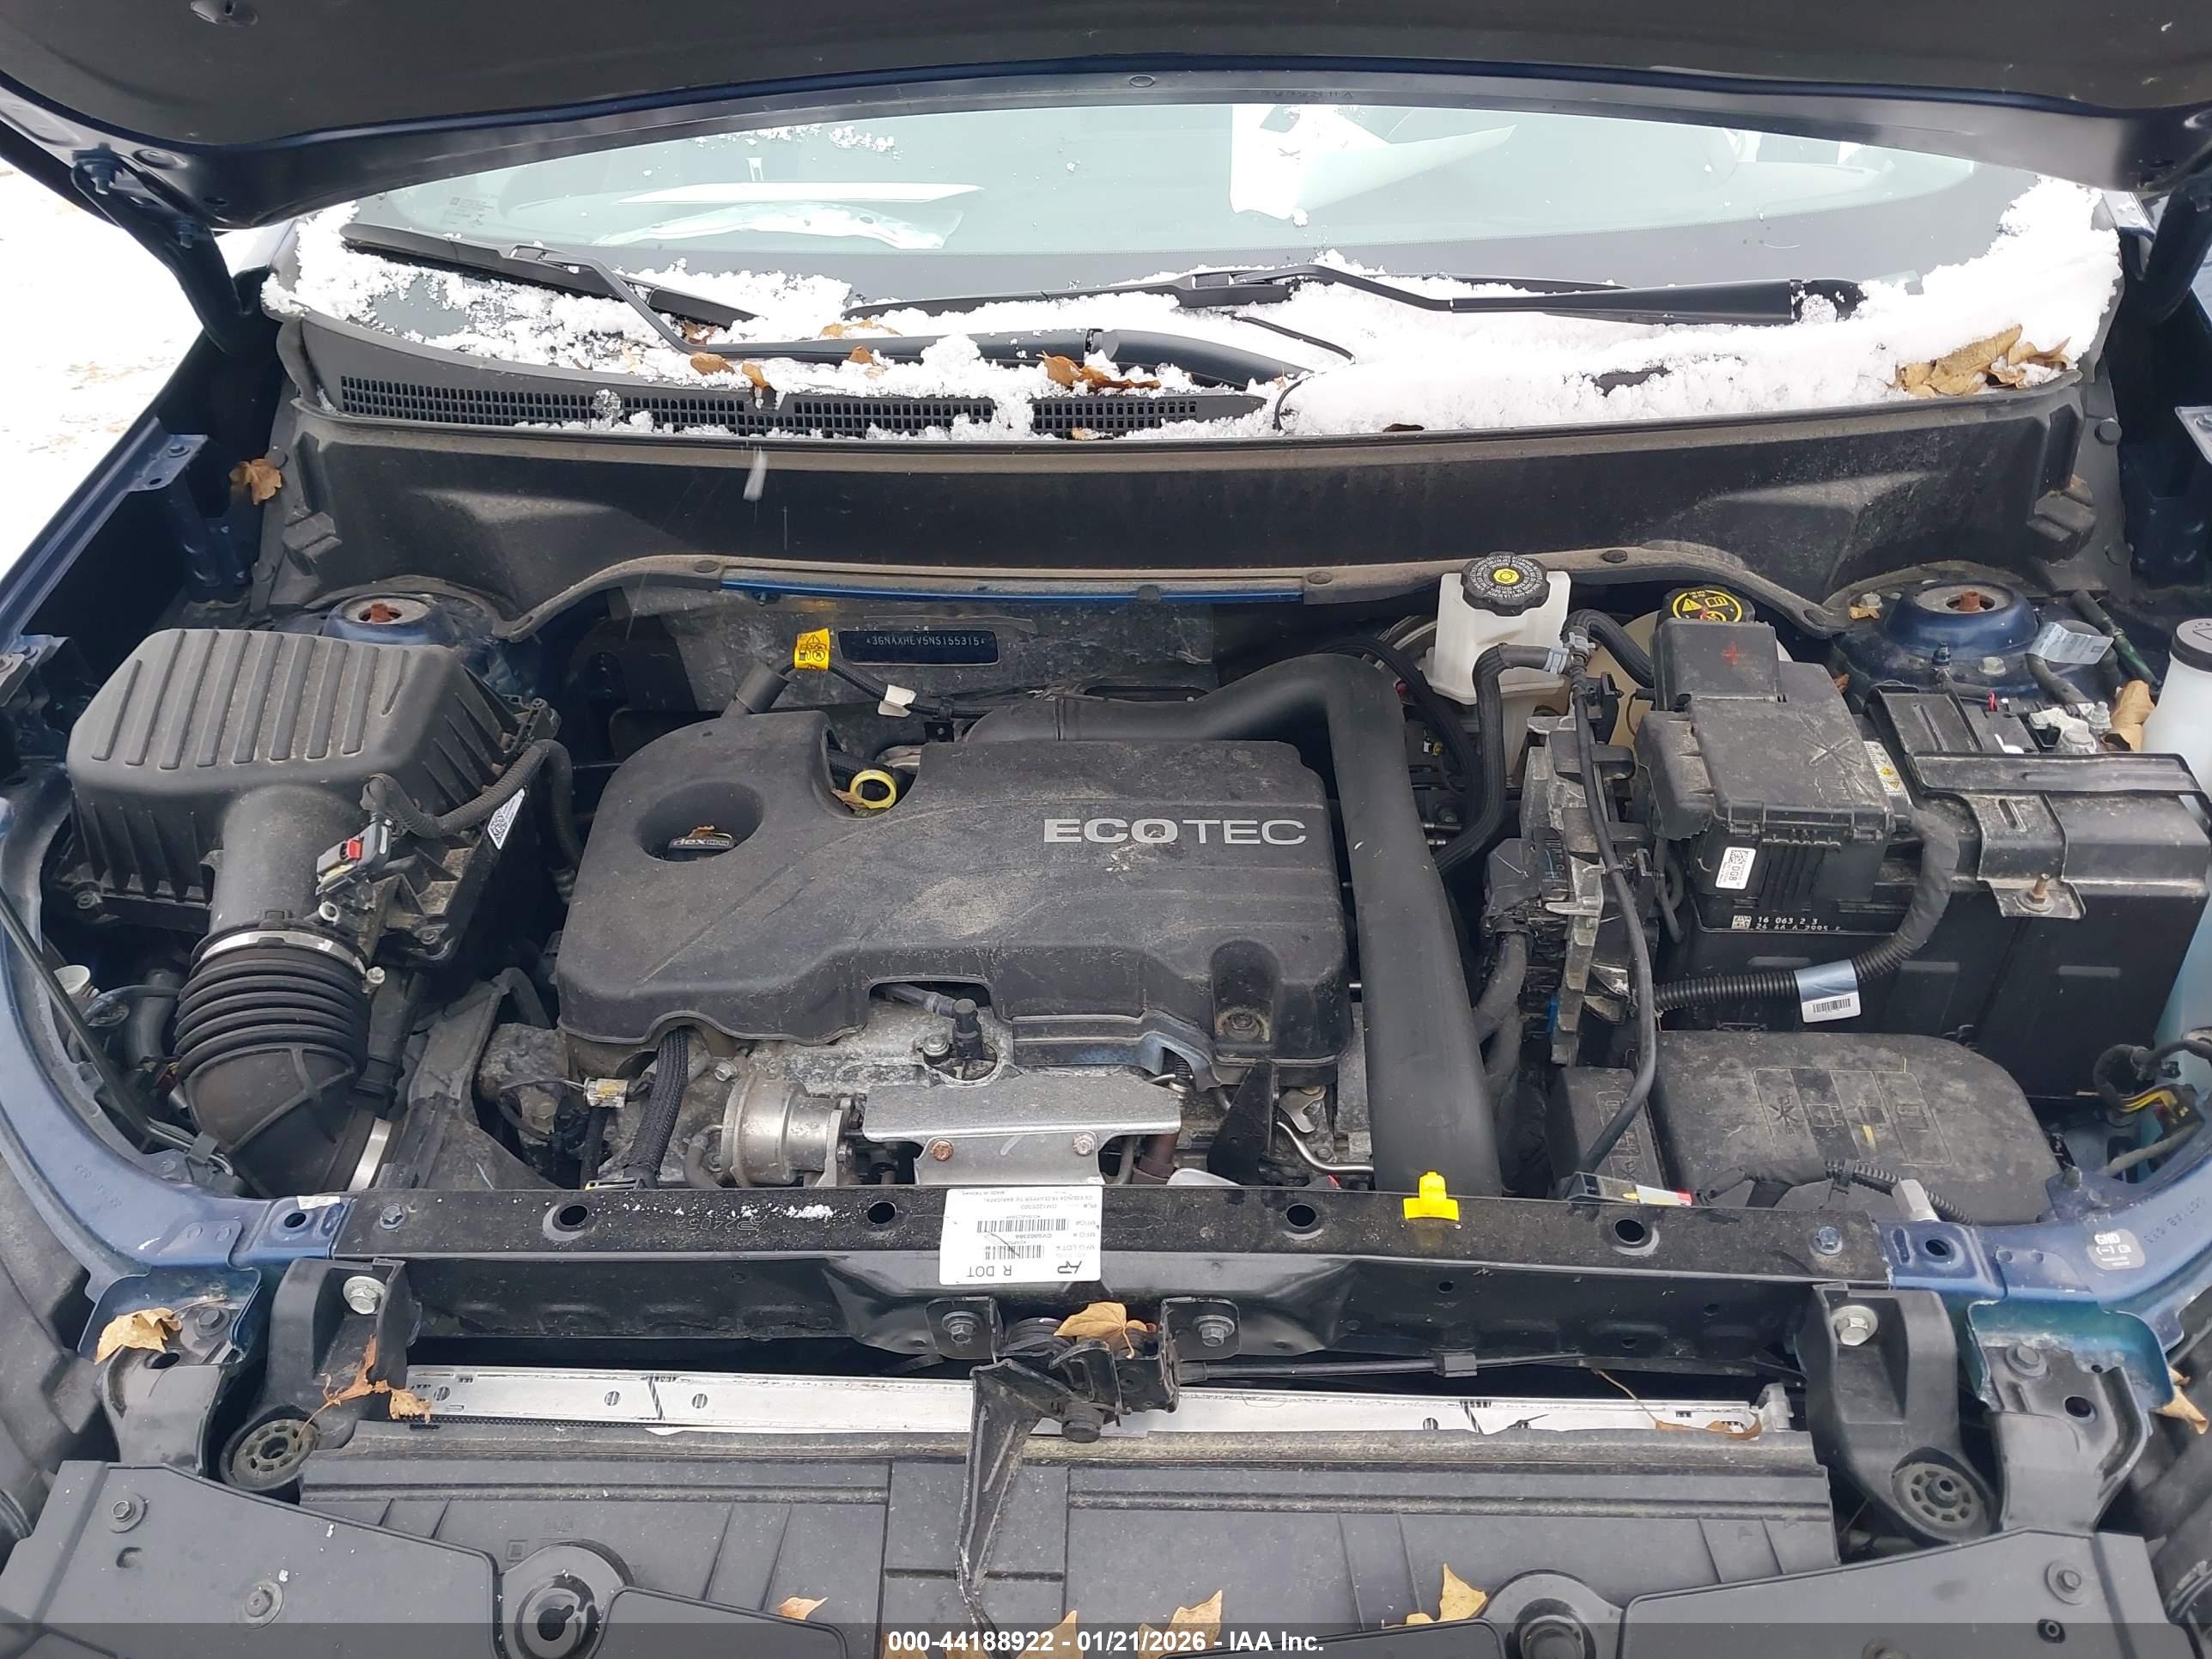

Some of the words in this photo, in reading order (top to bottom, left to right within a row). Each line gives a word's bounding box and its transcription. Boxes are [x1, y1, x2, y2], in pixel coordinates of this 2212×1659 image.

[1043, 817, 1307, 845] ECOTEC
[966, 1265, 995, 1278] DOT
[1003, 1265, 1012, 1277] R
